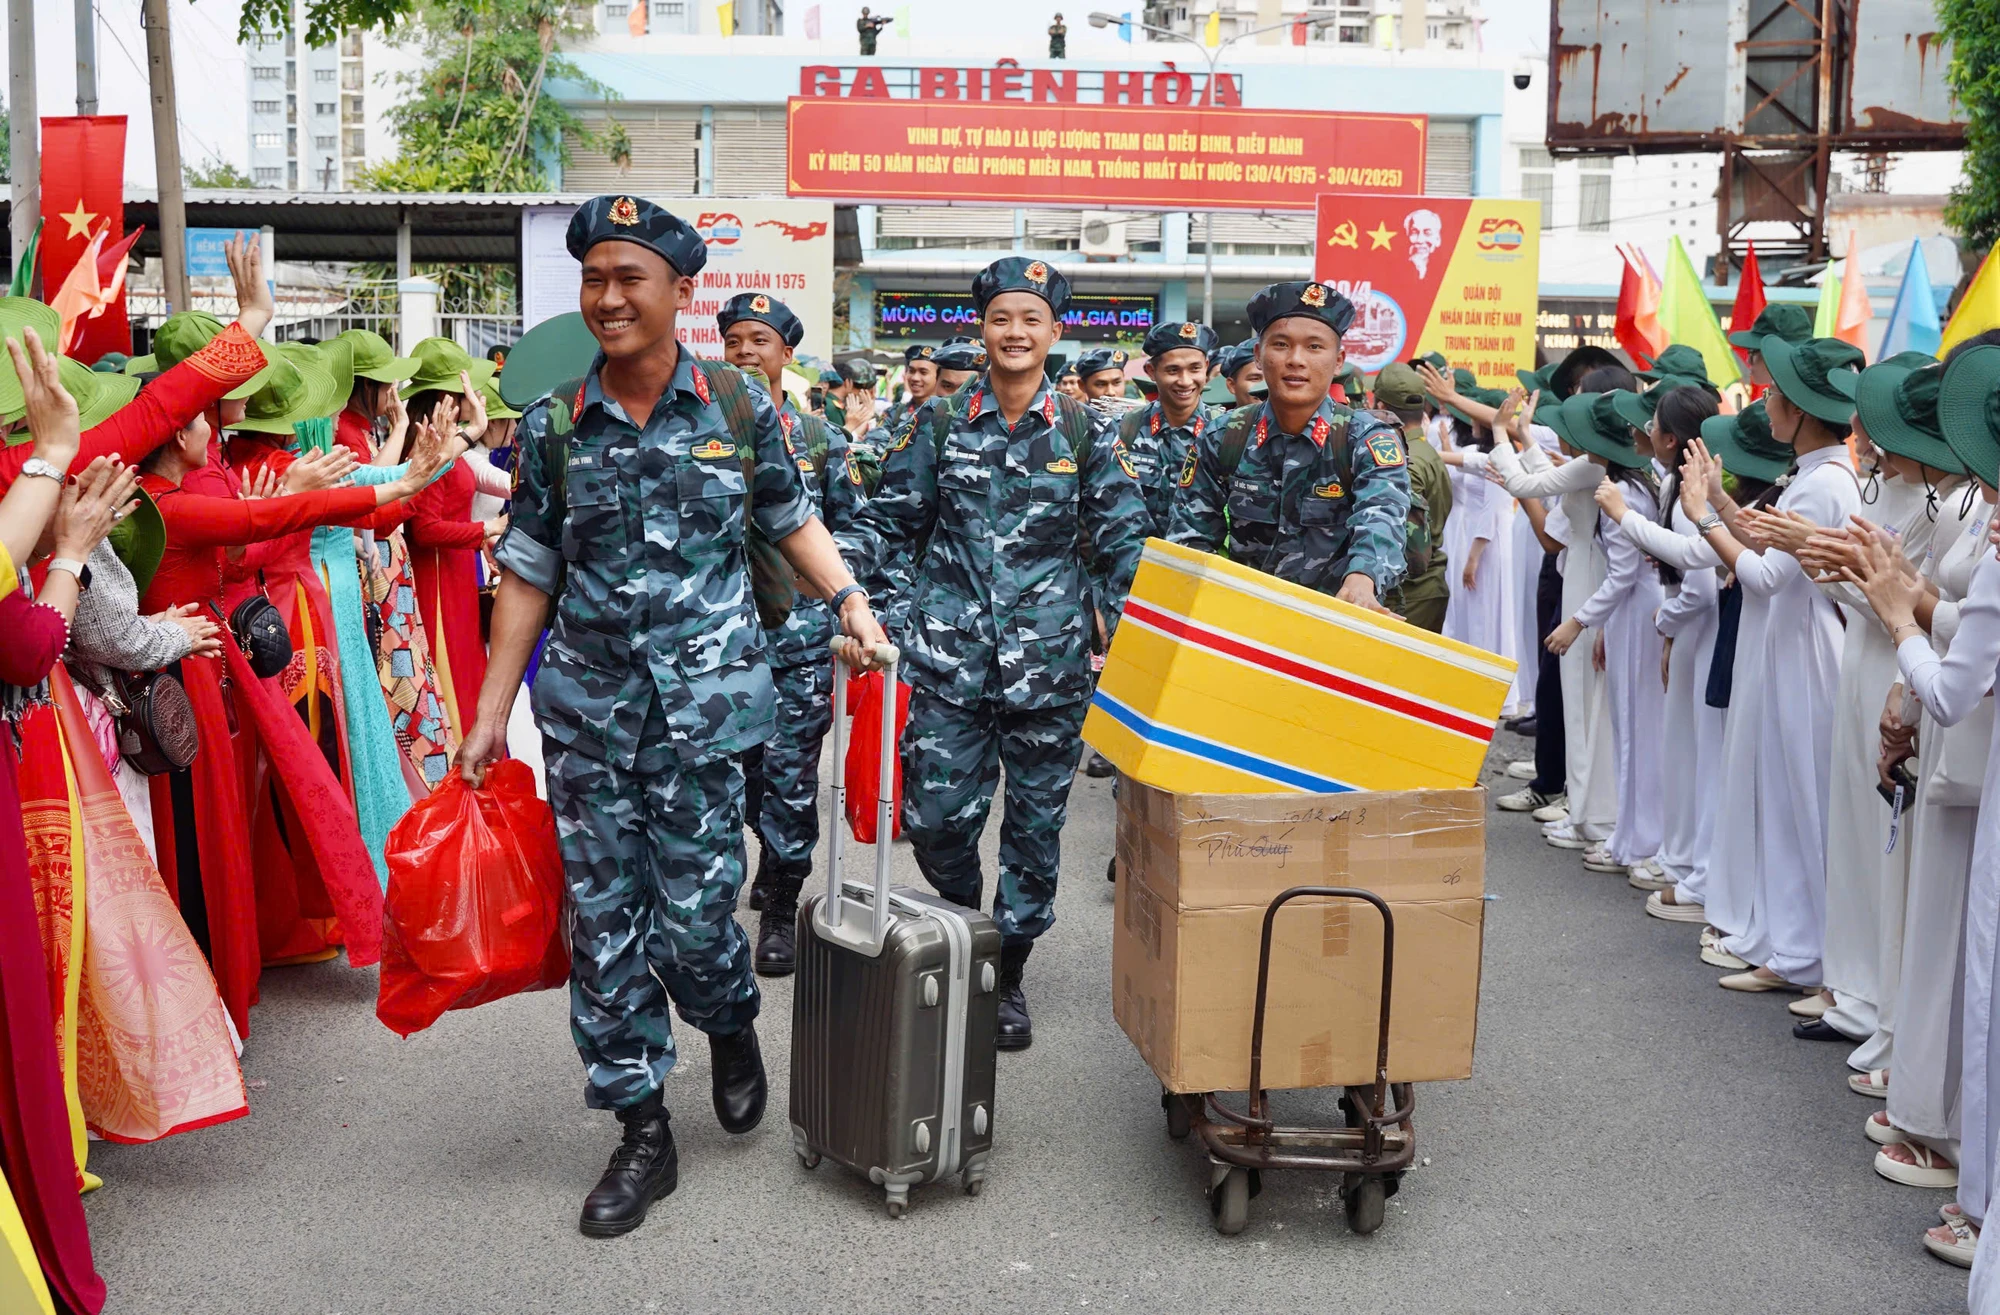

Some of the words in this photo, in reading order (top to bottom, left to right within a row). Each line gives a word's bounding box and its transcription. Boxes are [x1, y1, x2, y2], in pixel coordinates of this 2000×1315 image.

[800, 65, 890, 98] GA
[919, 58, 1078, 104] BIÊN
[1103, 61, 1242, 107] HÒA
[907, 127, 938, 145] VINH
[965, 126, 984, 150] TỰ
[985, 127, 1011, 147] HÀO
[1014, 128, 1029, 148] LÀ
[1032, 128, 1057, 151] LỰC
[1059, 128, 1101, 152] LƯỢNG
[1103, 132, 1140, 151] THAM
[1143, 133, 1165, 151] GIA
[1200, 135, 1234, 154] BINH,
[1268, 135, 1304, 156] HÀNH
[828, 150, 860, 175] NIỆM
[863, 154, 881, 172] 50
[884, 152, 913, 173] NĂM
[916, 153, 950, 174] NGÀY
[953, 152, 979, 174] GIẢI
[982, 155, 1026, 176] PHÓNG
[1028, 153, 1061, 176] MIỀN
[1063, 159, 1095, 179] NAM,
[1098, 155, 1140, 179] THỐNG
[1143, 156, 1177, 180] NHẤT
[1179, 157, 1205, 180] ĐẤT
[1207, 160, 1242, 182] NƯỚC
[1245, 164, 1317, 185] (30/4/1975
[1328, 167, 1403, 187] 30/4/2025)
[703, 269, 732, 289] MÙA
[735, 270, 771, 289] XUÂN
[775, 274, 806, 290] 1975
[1463, 284, 1486, 302] QUÂN
[1488, 284, 1502, 305] ĐỘI
[882, 304, 938, 323] MỪNG
[941, 305, 979, 324] CÁC
[1087, 310, 1118, 326] GIA
[1440, 307, 1463, 325] NHÂN
[1465, 308, 1482, 325] DÂN
[1484, 309, 1501, 330] VIỆT
[1503, 312, 1522, 327] NAM
[1574, 315, 1593, 329] TY
[1445, 336, 1471, 351] TRUNG
[1473, 334, 1500, 351] THÀNH
[1502, 335, 1515, 352] VỚI
[1544, 333, 1579, 349] KHAI
[1583, 331, 1622, 349] THÁC
[1478, 358, 1491, 377] VỚI
